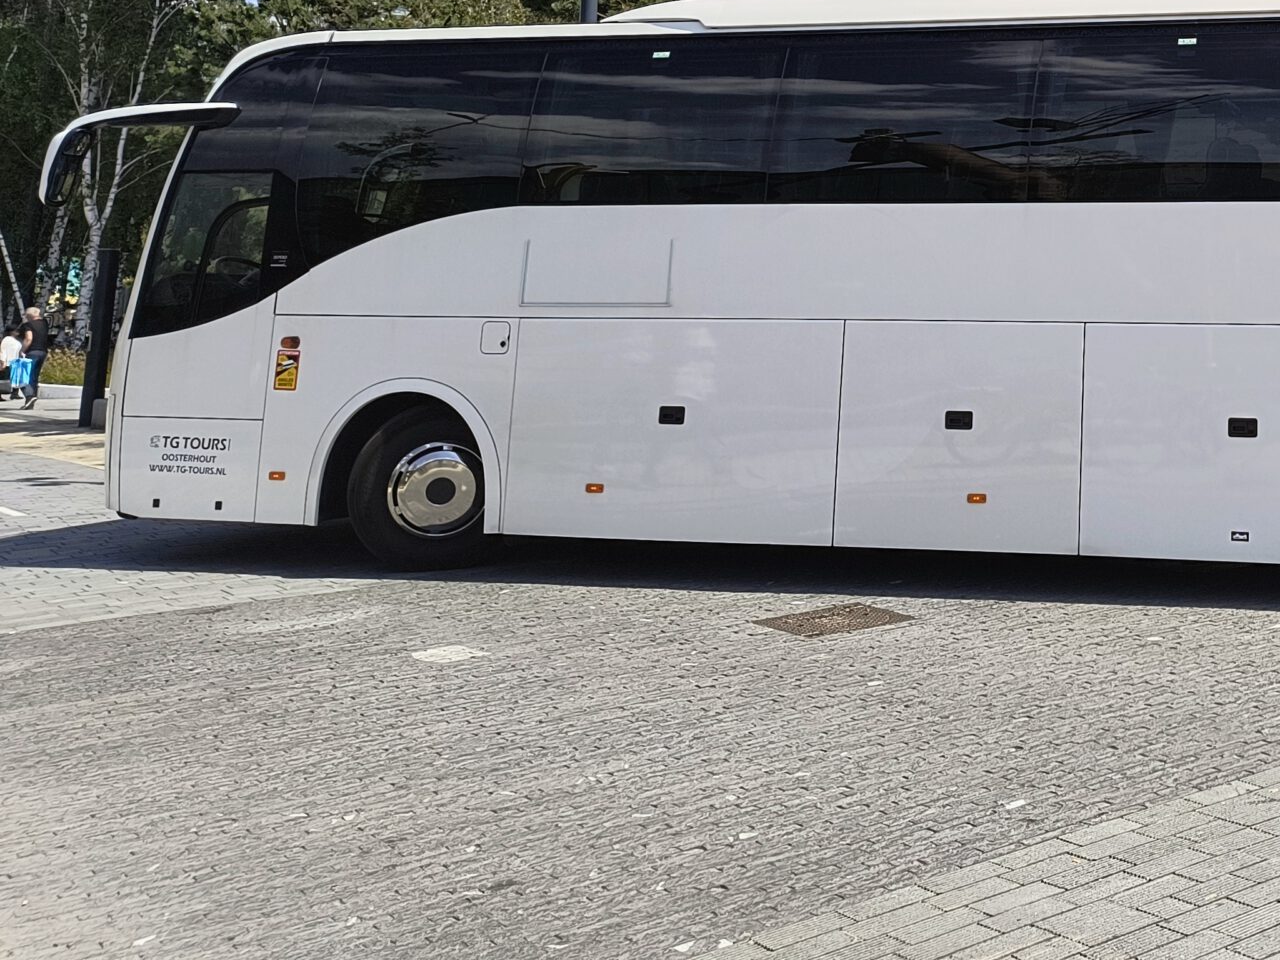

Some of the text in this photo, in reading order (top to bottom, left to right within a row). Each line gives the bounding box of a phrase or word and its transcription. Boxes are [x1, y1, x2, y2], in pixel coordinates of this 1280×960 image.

[162, 435, 227, 451] TG TOURS
[161, 453, 217, 463] OOSTERHOUT
[148, 464, 227, 476] WWW.TG-TOURS.NL
